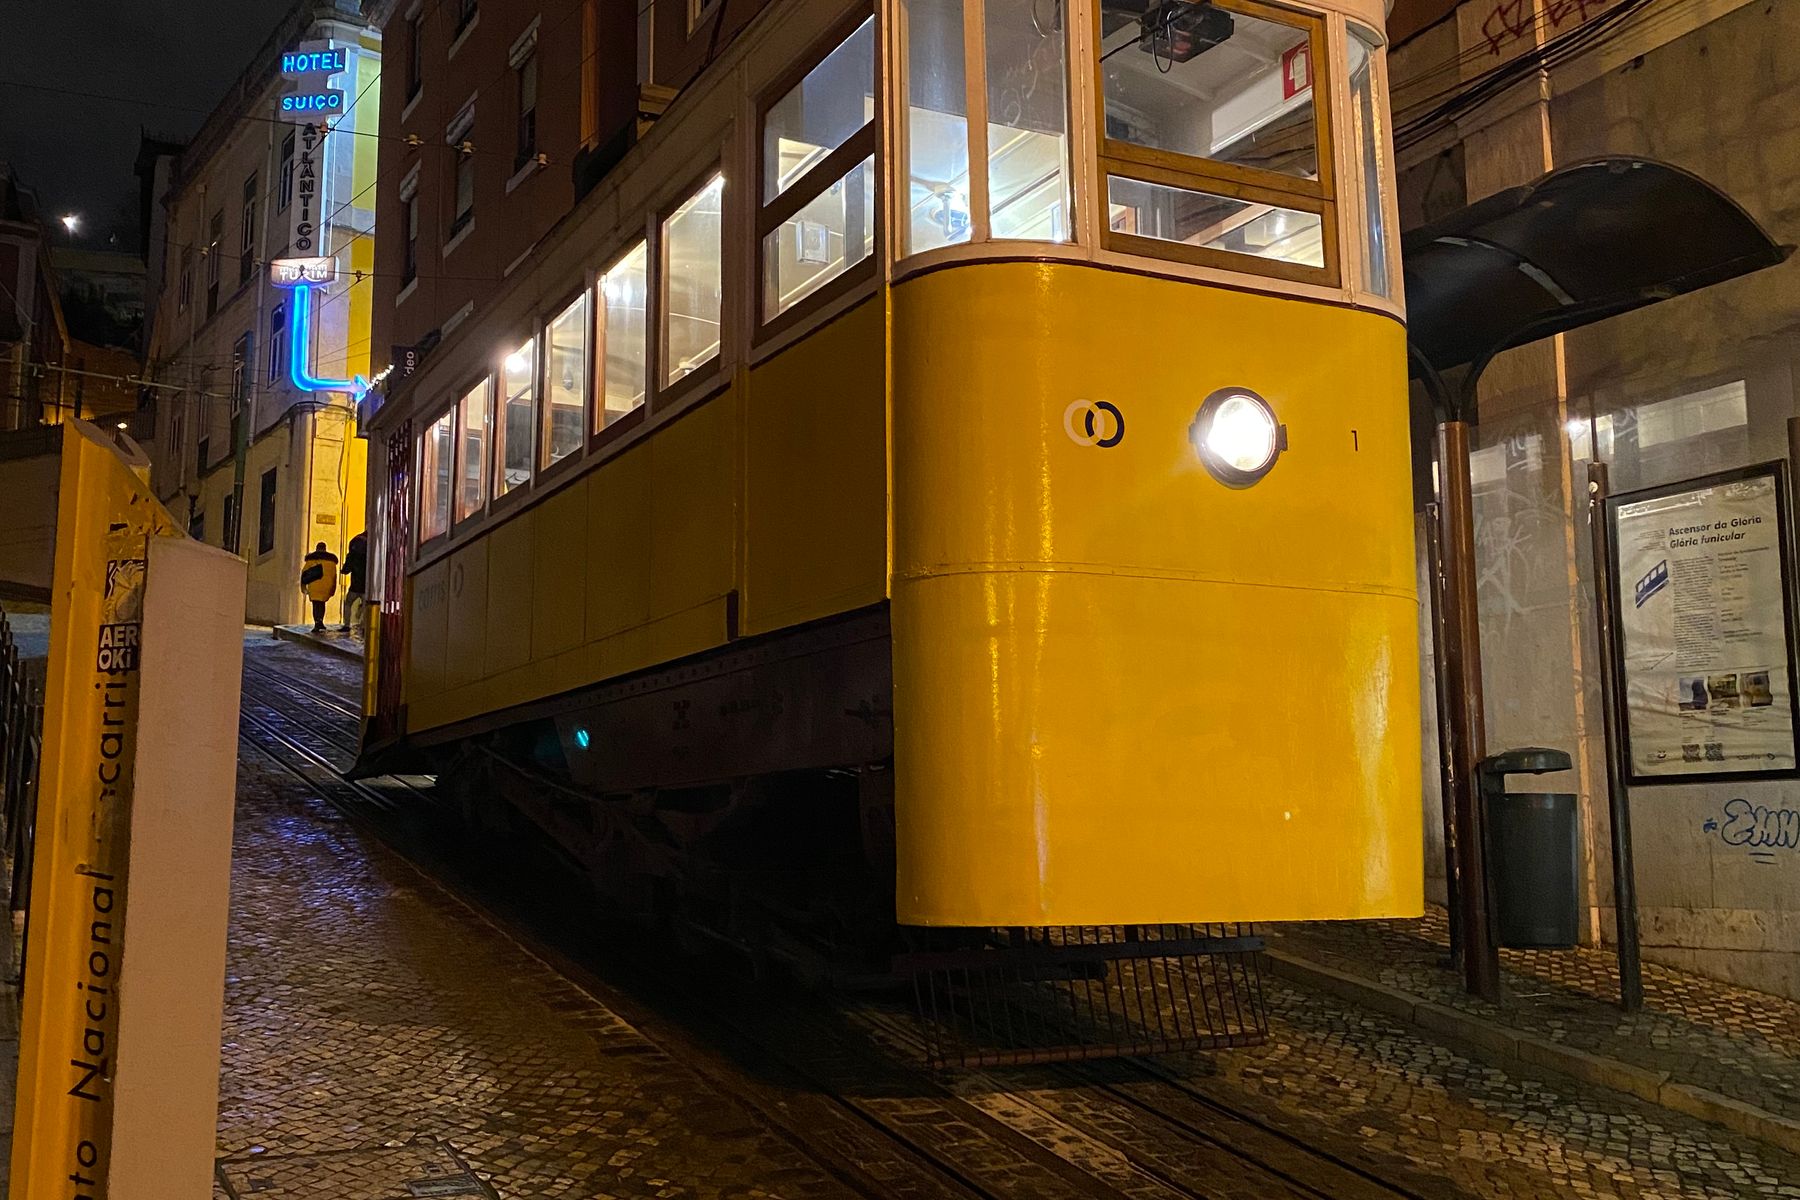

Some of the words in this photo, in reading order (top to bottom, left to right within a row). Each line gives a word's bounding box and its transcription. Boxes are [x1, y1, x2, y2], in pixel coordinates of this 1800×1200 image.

[282, 52, 344, 73] HOTEL
[282, 94, 340, 111] SUIÇO
[1669, 523, 1712, 537] Ascensor
[1714, 520, 1728, 531] da
[1701, 531, 1746, 545] funicular
[100, 625, 140, 648] AER
[67, 864, 115, 1101] Nacional
